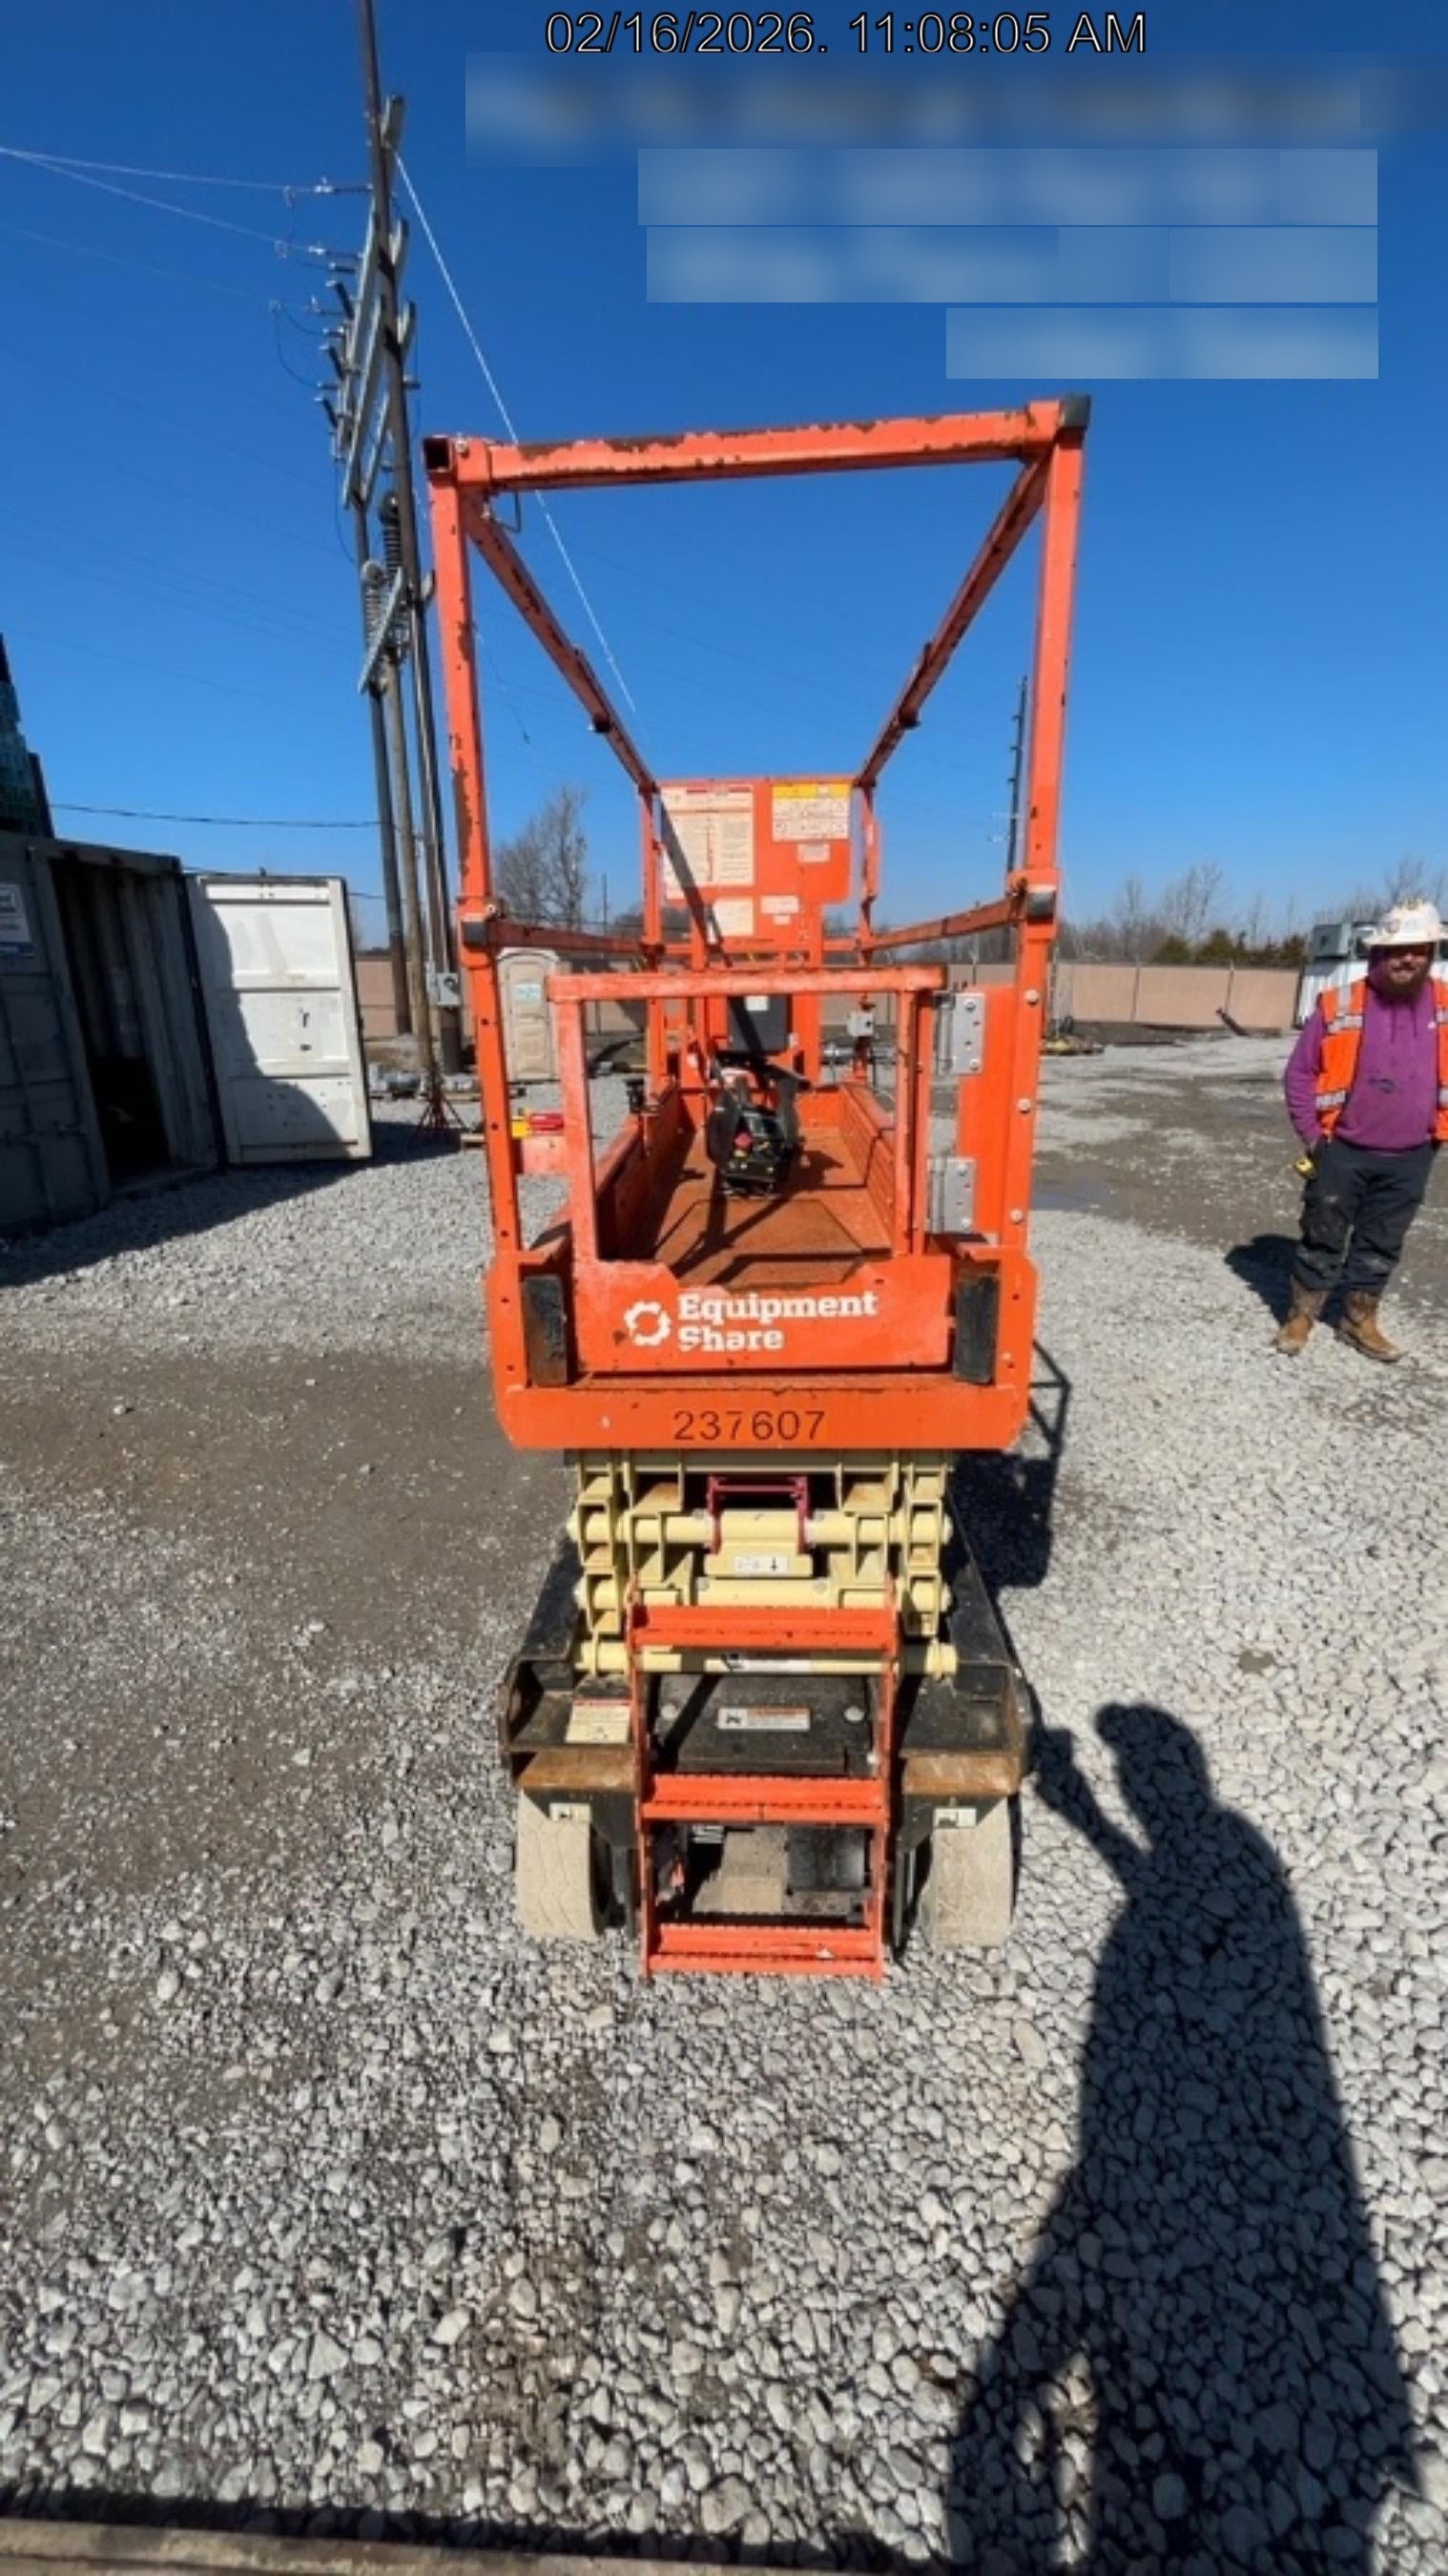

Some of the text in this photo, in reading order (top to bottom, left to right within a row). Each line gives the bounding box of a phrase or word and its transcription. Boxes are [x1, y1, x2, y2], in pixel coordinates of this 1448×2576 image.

[677, 1291, 879, 1325] Equipment
[677, 1324, 785, 1352] Share
[673, 1410, 825, 1441] 237607
